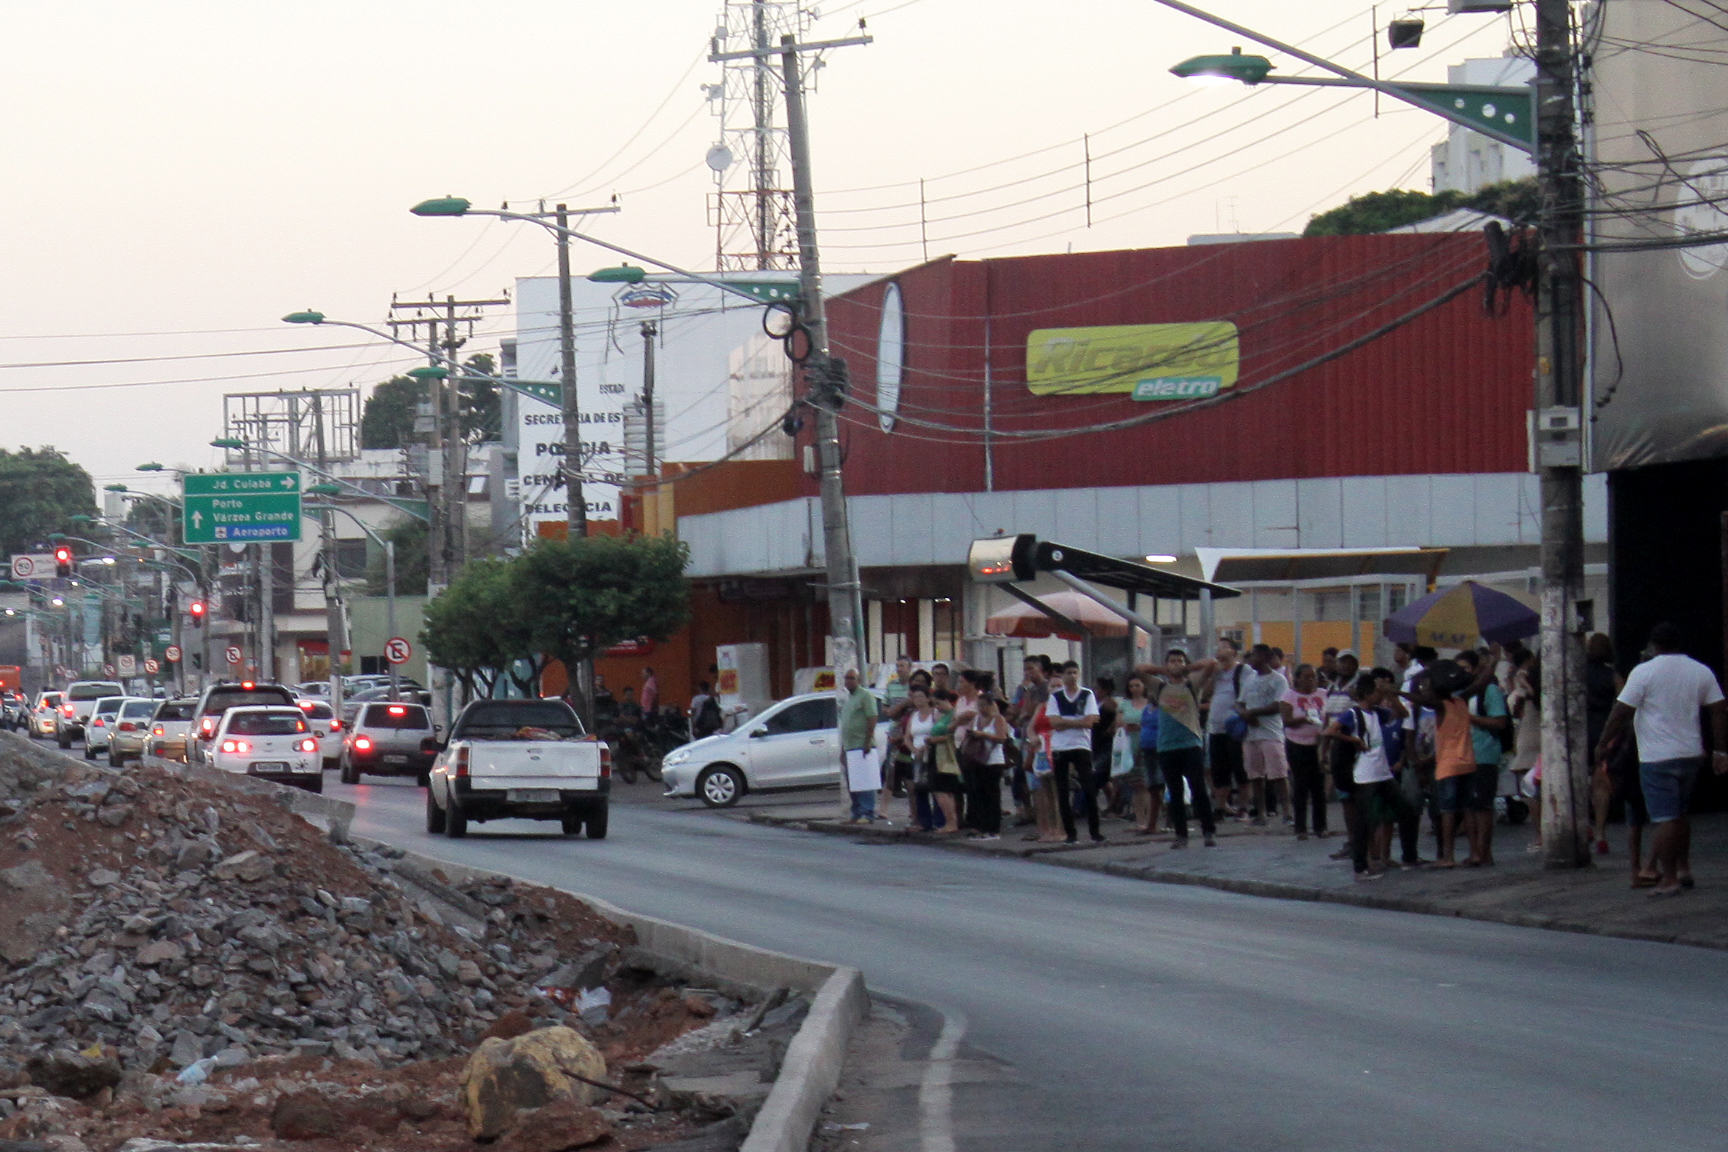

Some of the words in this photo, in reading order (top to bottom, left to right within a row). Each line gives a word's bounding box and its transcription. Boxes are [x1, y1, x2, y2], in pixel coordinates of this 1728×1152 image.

[1137, 378, 1219, 397] eletro
[524, 413, 591, 425] SECREIA
[607, 413, 623, 423] ES
[536, 441, 610, 456] POCIA
[212, 499, 243, 508] Porto
[254, 511, 294, 521] Grande
[232, 527, 289, 537] Aeroporto
